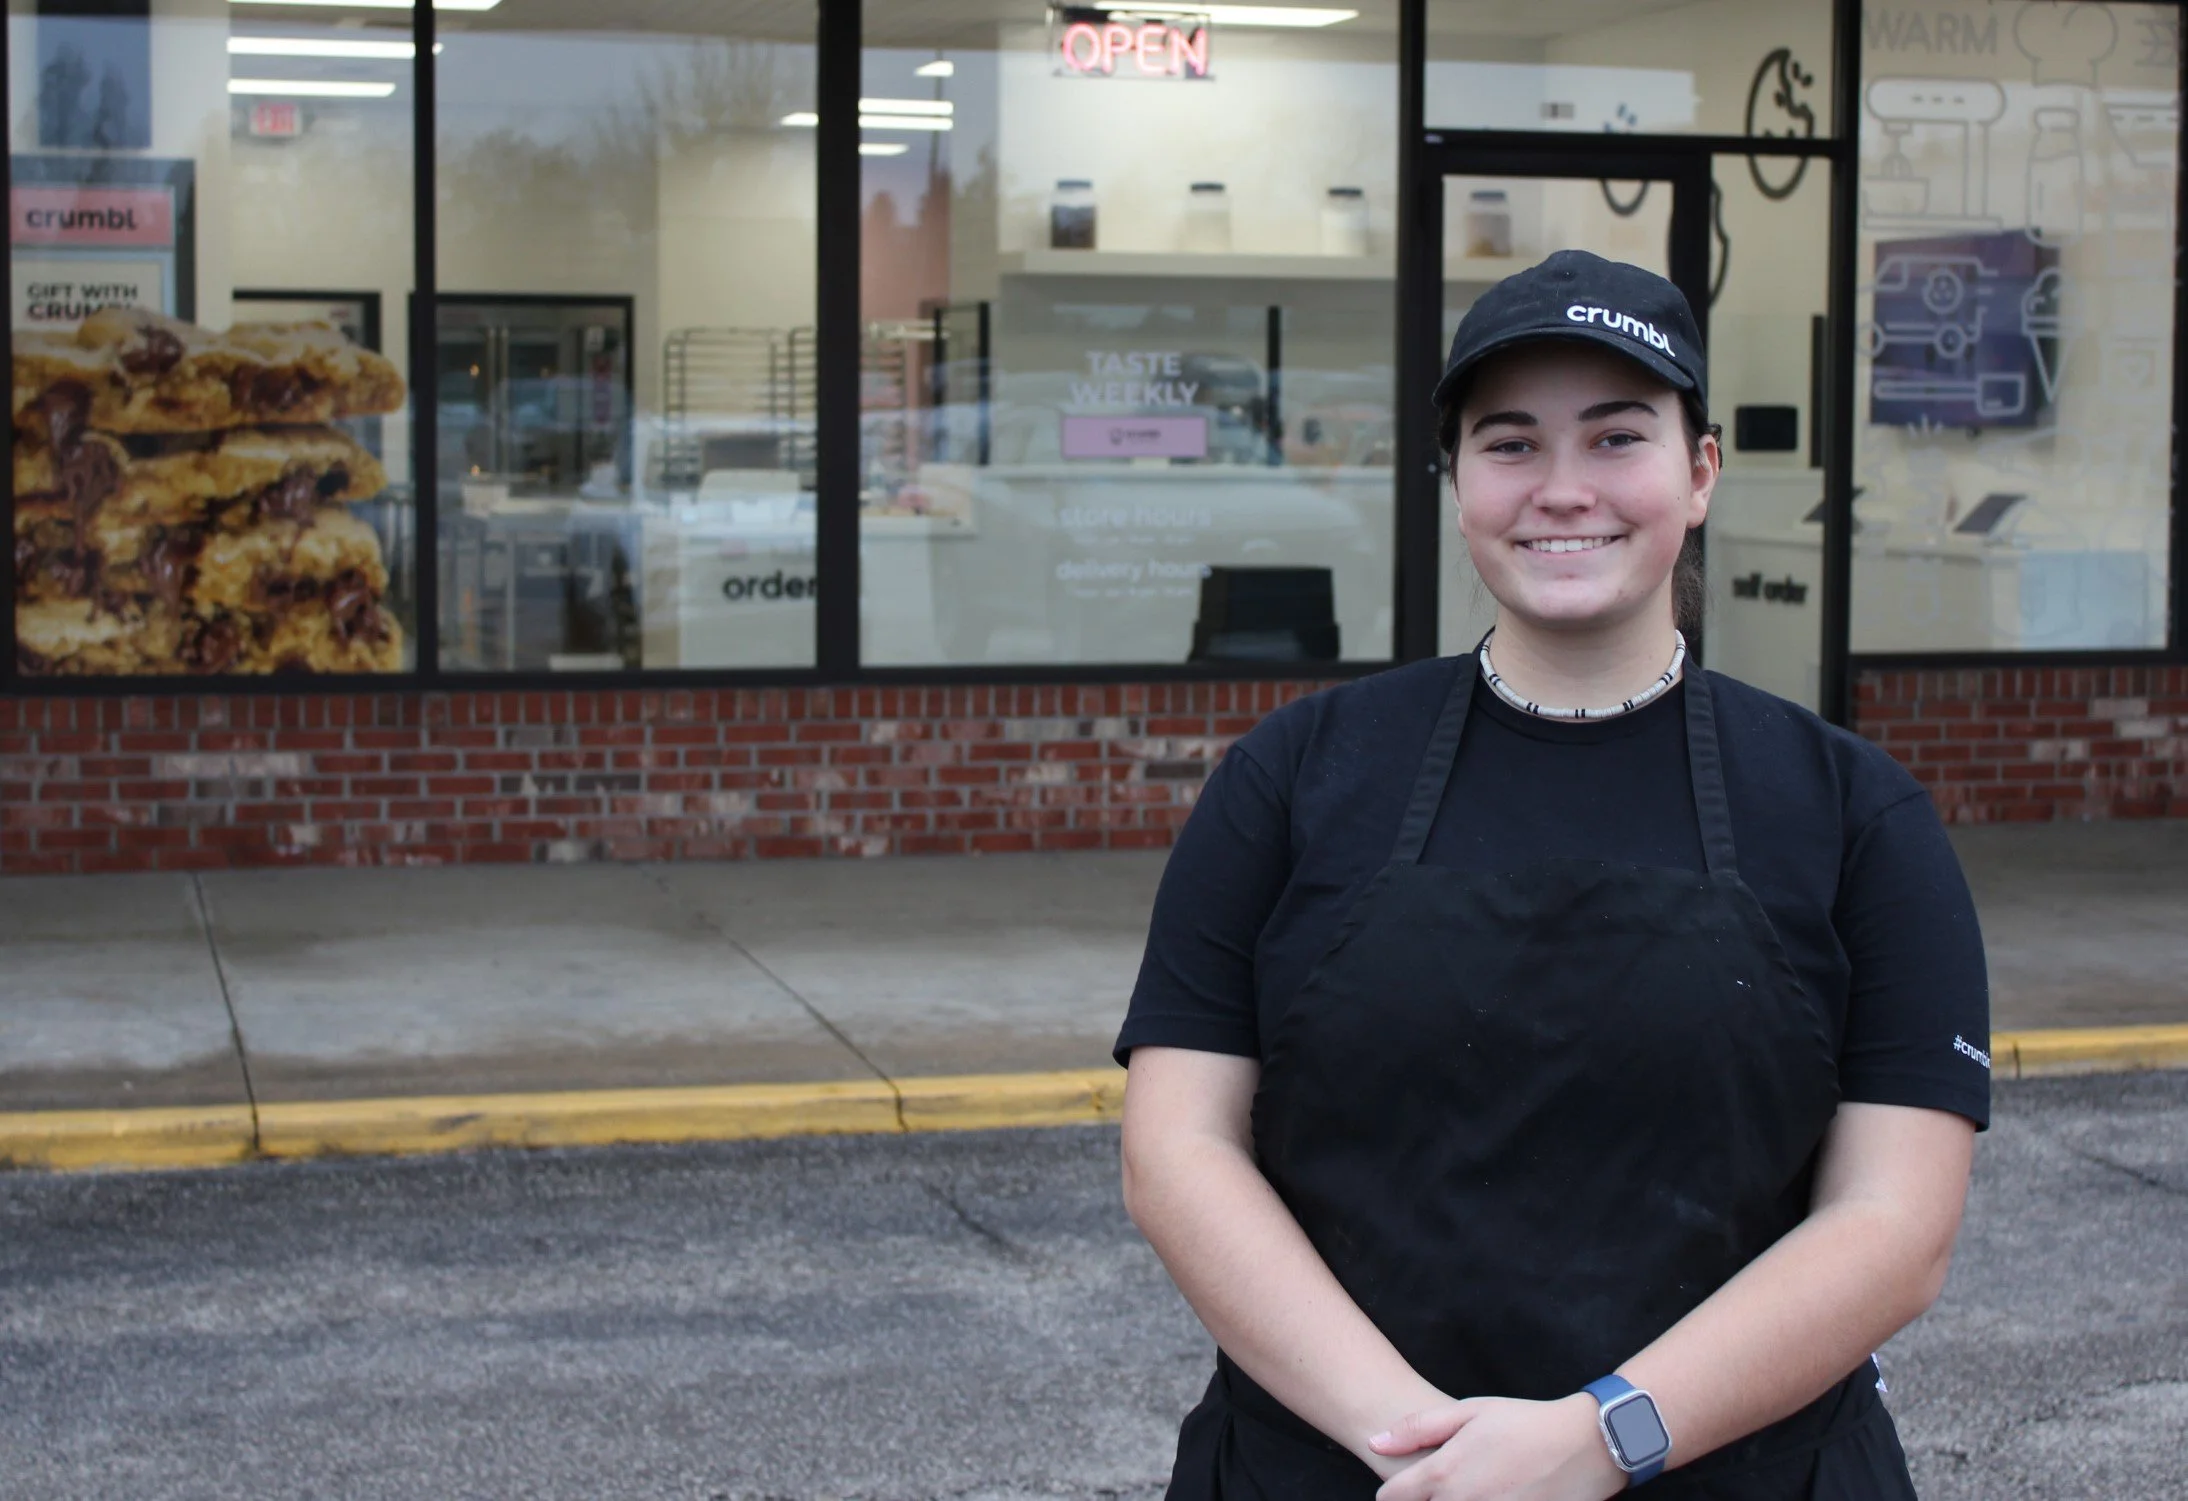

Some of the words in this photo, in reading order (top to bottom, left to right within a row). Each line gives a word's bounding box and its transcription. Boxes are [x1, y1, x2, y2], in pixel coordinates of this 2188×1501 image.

[1062, 22, 1208, 76] OPEN
[26, 207, 138, 231] crumbl
[27, 283, 72, 298] GIFT
[81, 283, 138, 298] WITH
[1566, 304, 1676, 358] crumbl
[1083, 351, 1182, 378] TASTE
[1067, 380, 1200, 406] WEEKLY
[722, 568, 818, 601] order
